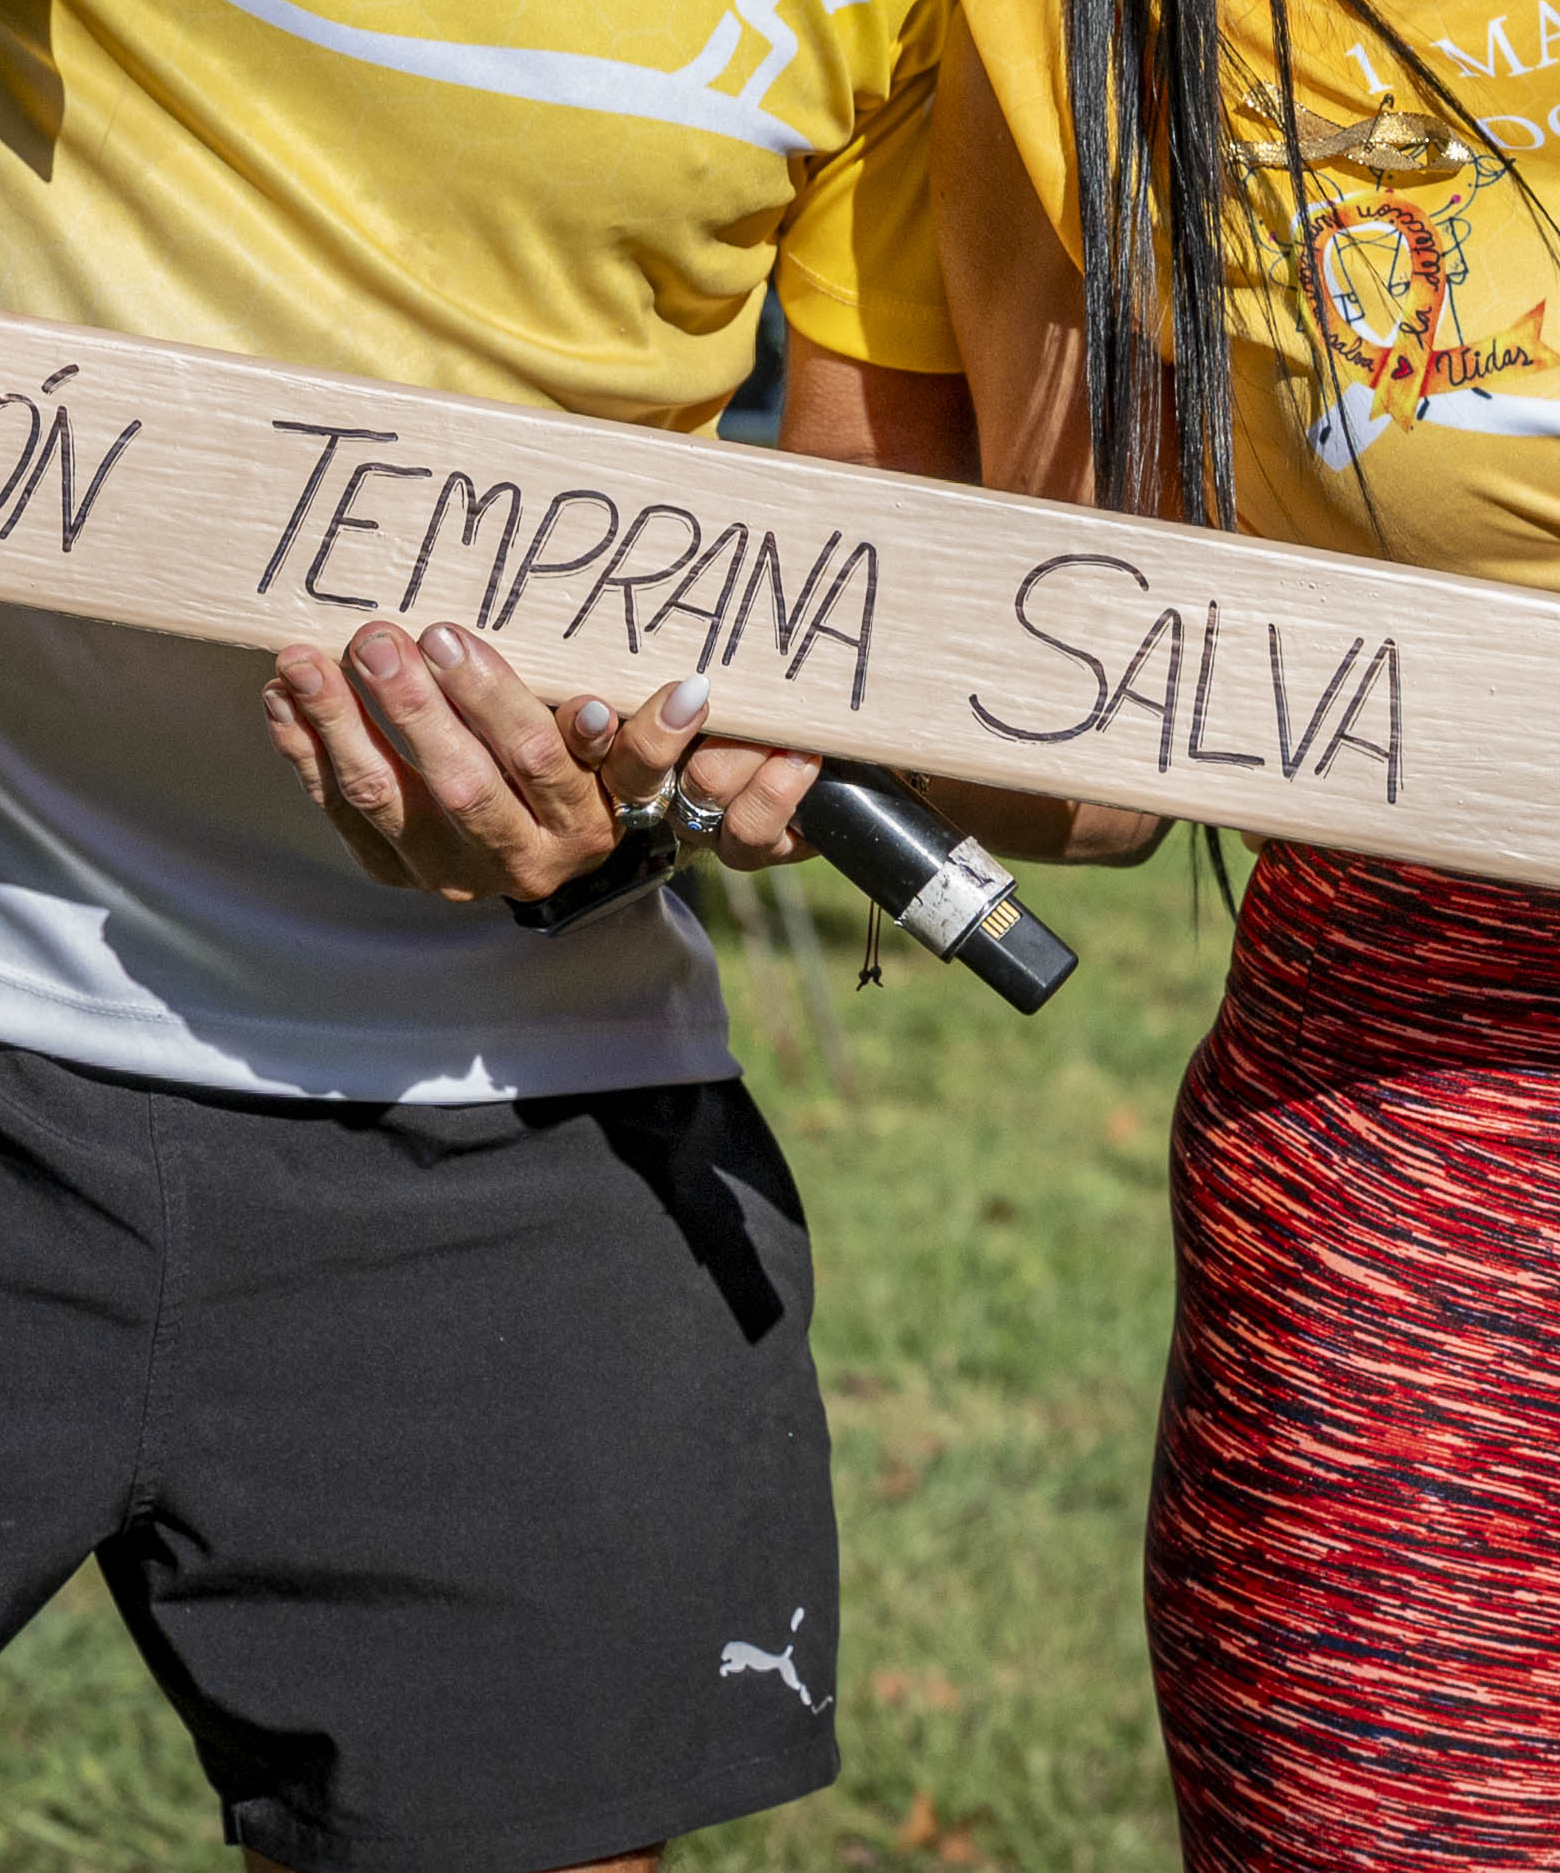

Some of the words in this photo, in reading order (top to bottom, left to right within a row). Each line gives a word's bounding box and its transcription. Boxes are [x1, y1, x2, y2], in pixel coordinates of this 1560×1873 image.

[1435, 338, 1534, 387] Vidas
[258, 419, 880, 713] TEMPRANA
[969, 551, 1404, 804] SALVA
